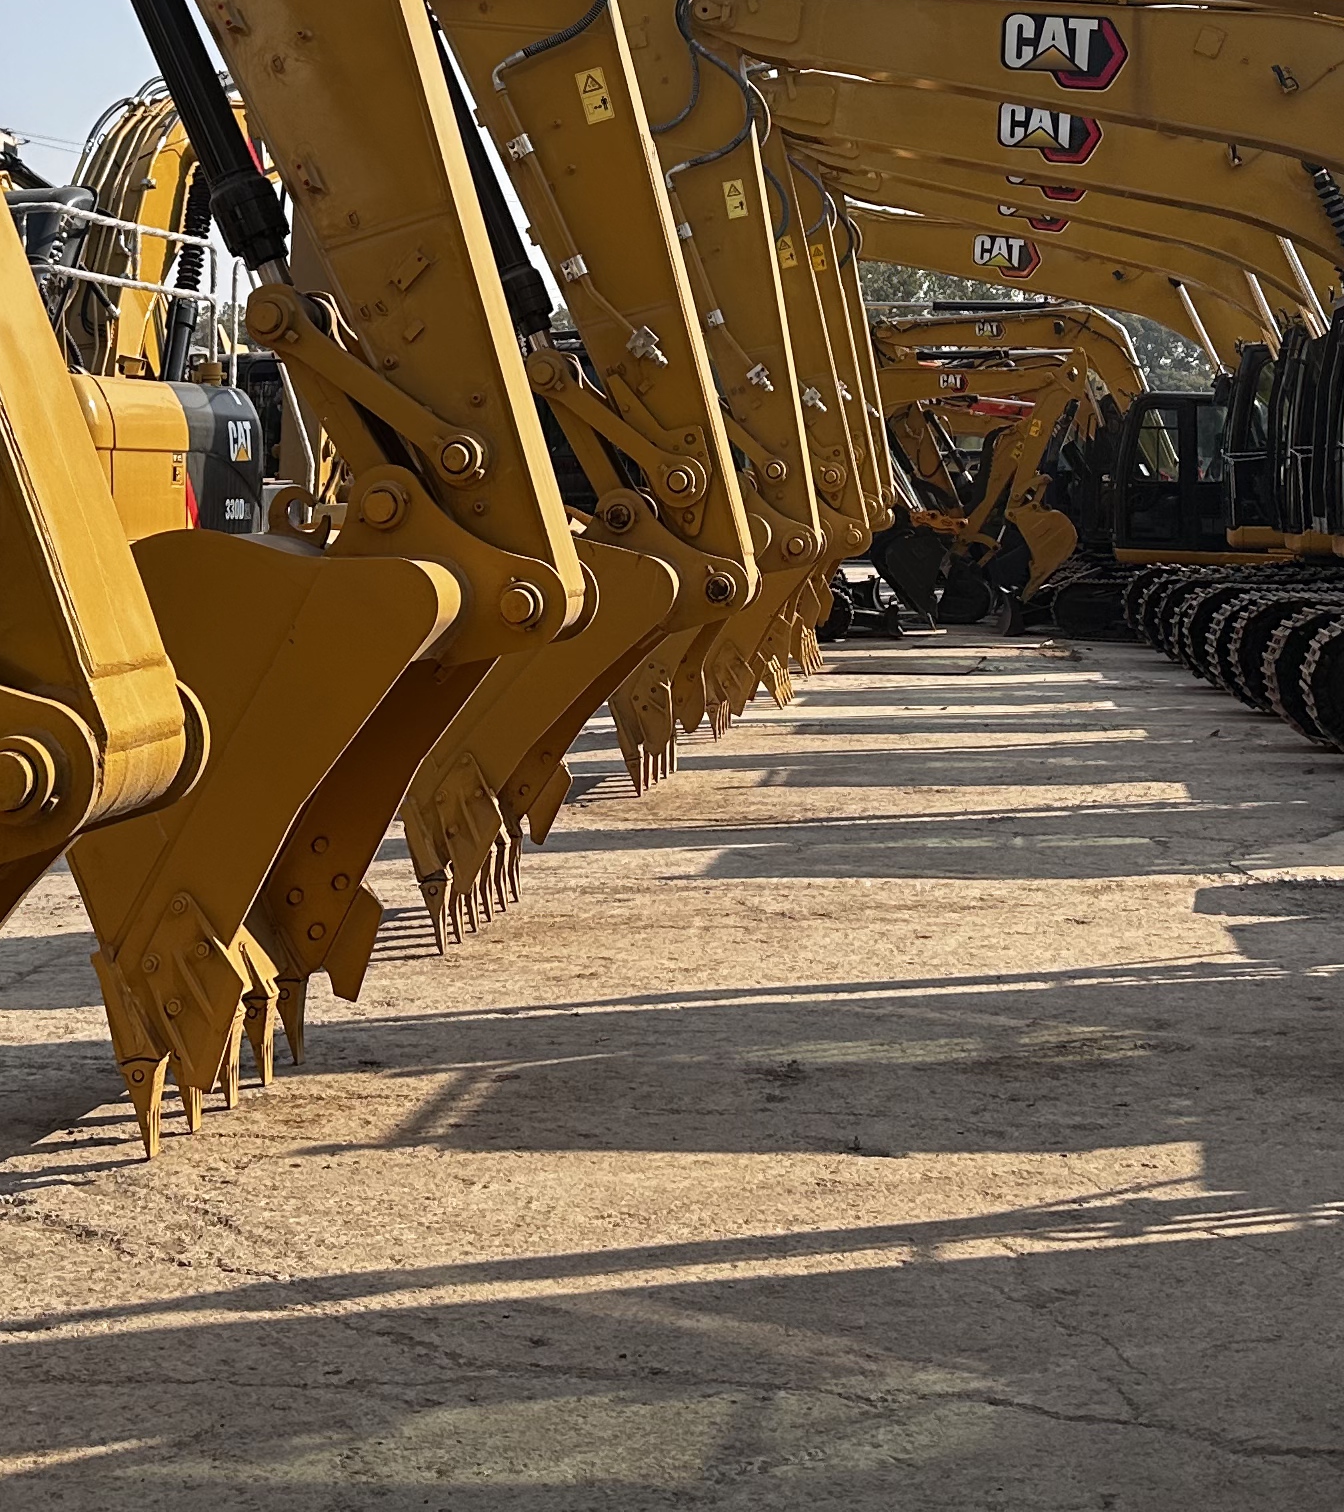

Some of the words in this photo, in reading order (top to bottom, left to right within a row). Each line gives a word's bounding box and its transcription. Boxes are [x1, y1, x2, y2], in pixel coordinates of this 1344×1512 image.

[1004, 13, 1099, 72] CAT
[974, 234, 1025, 268] CAT
[975, 320, 999, 337] CAT
[939, 373, 962, 389] CAT
[228, 420, 252, 461] CAT
